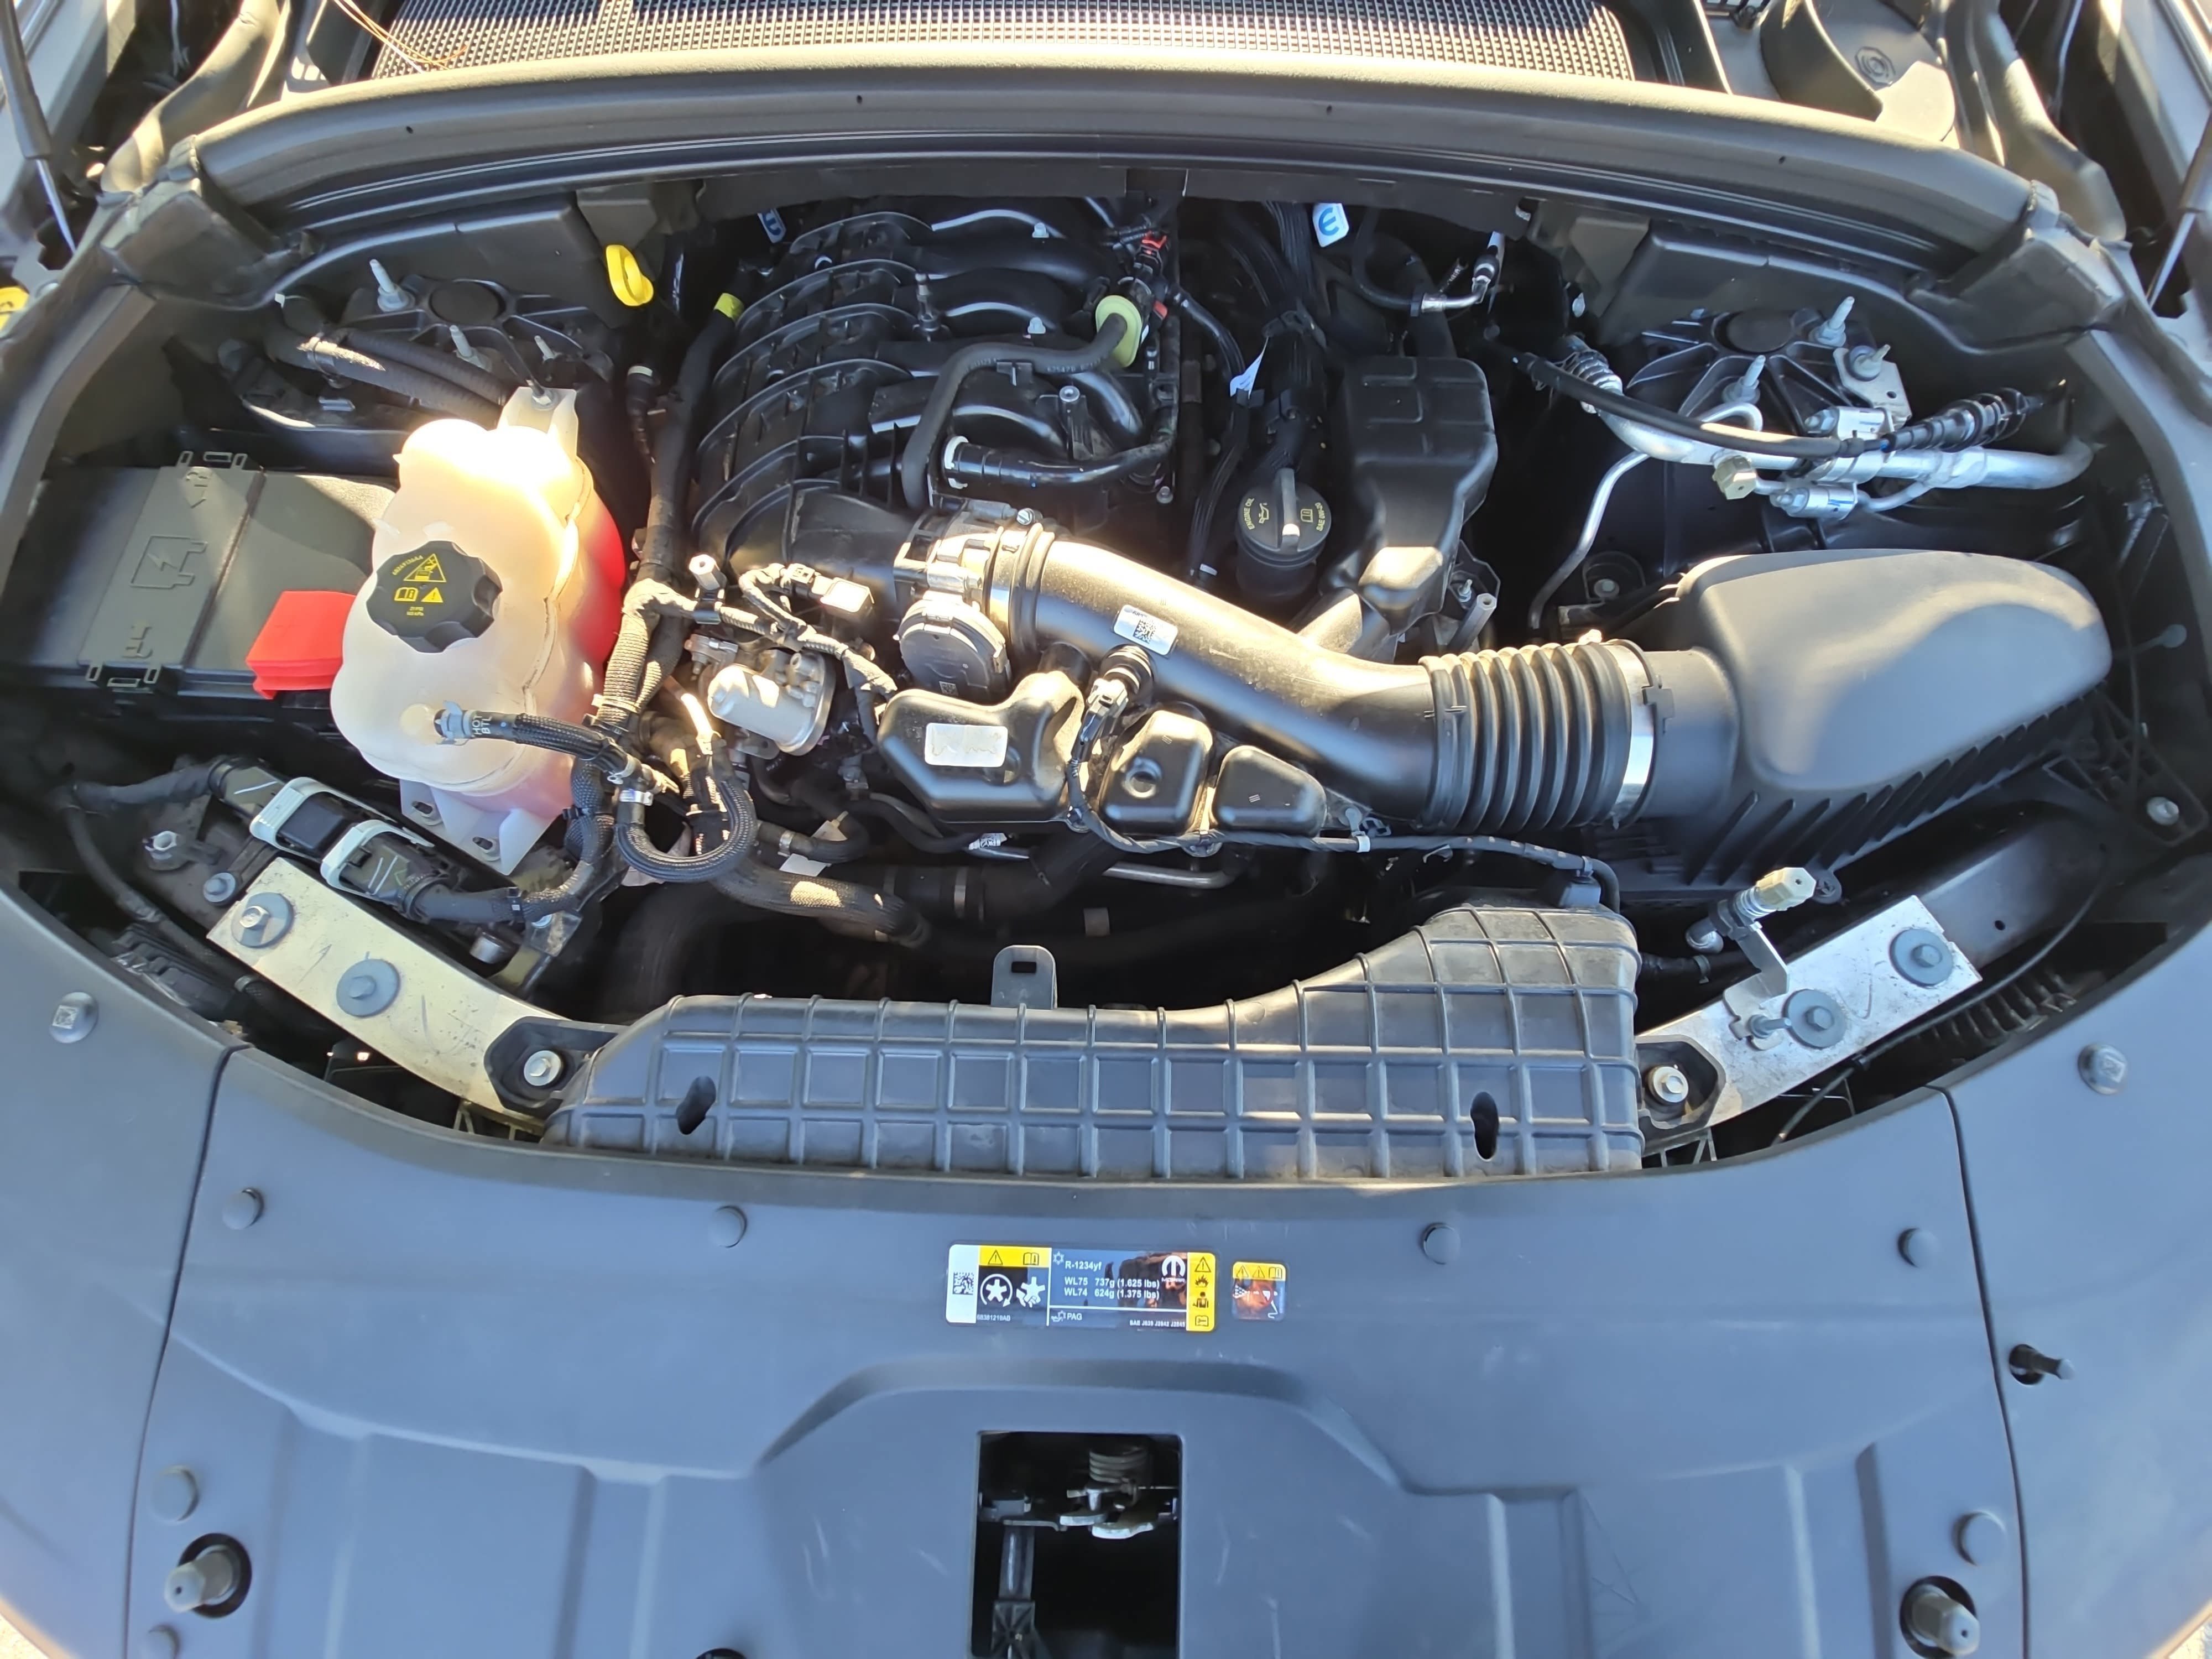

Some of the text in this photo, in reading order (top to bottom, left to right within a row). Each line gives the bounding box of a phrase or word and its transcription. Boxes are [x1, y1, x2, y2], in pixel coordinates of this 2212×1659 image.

[1244, 498, 1255, 530] ENGINE OIL
[1316, 518, 1326, 531] SAE
[472, 716, 482, 735] HOT
[481, 717, 492, 734] BTL
[1065, 1261, 1102, 1272] R-1234yf
[1065, 1277, 1160, 1289] WL75 737g (1.625 lbs)
[1065, 1287, 1160, 1300] WL74 624g (1.375 lbs)
[1067, 1312, 1083, 1321] PAG
